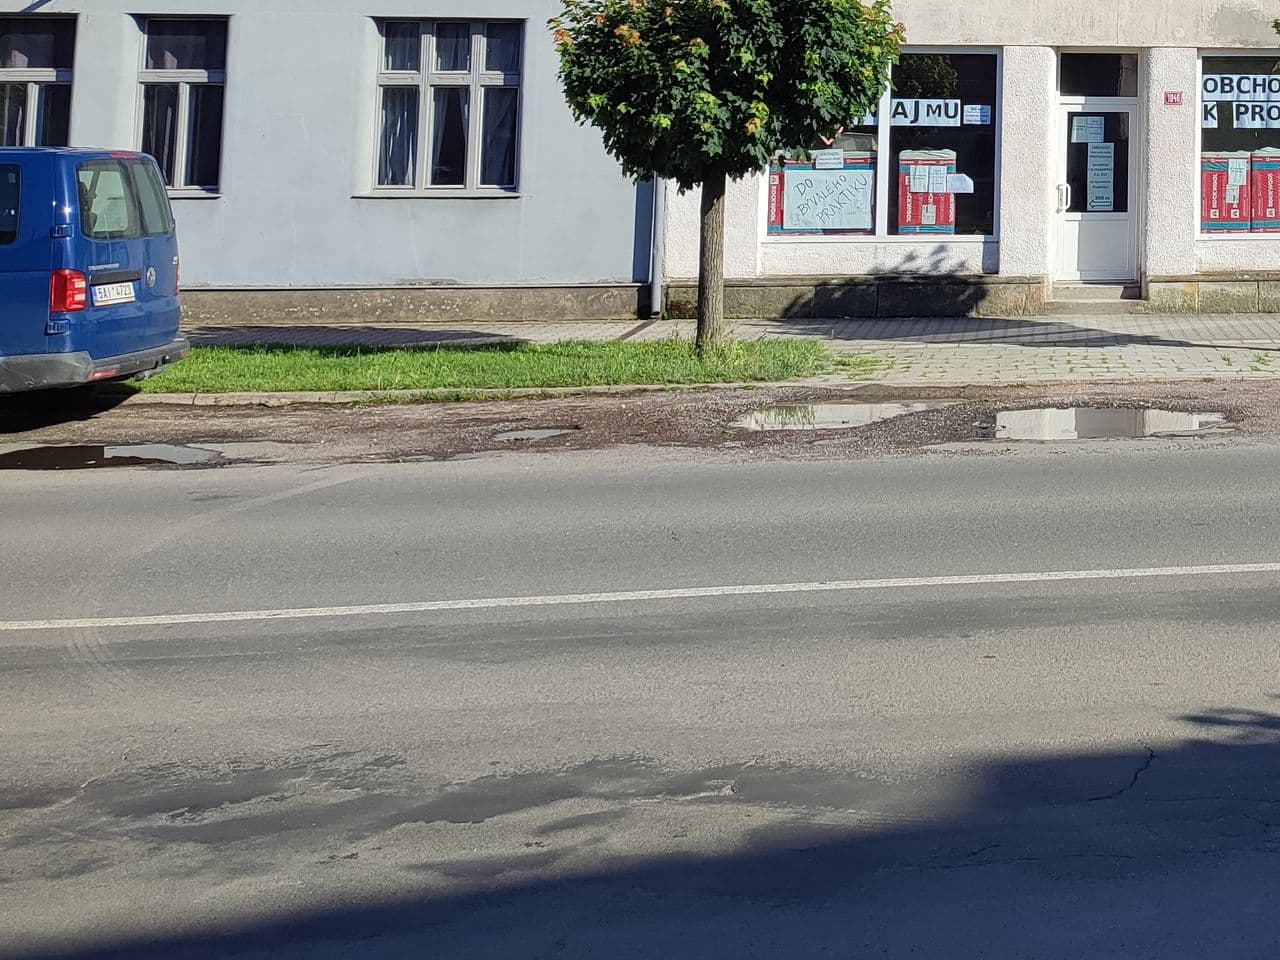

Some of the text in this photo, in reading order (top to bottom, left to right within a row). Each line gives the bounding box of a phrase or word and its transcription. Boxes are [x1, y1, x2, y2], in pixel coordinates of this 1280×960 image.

[870, 100, 959, 124] AJMU
[1203, 103, 1217, 121] K
[794, 178, 813, 196] DO
[816, 174, 868, 224] PRAKTIKU
